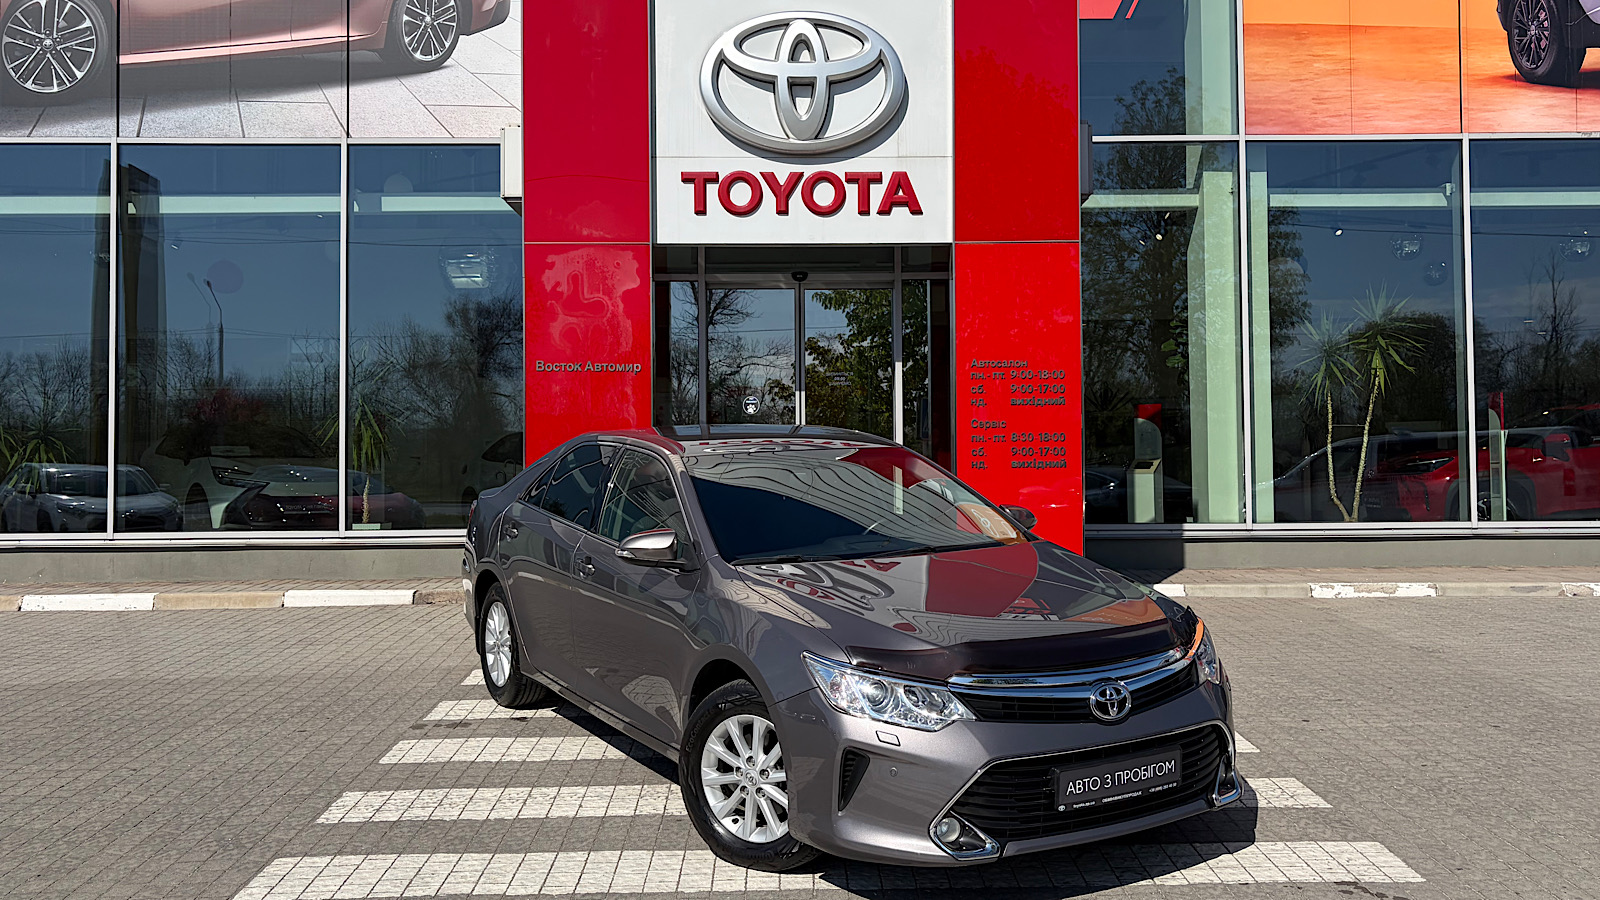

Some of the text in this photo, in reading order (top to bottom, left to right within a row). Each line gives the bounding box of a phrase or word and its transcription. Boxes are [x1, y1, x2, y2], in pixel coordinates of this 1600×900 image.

[681, 170, 923, 217] TOYOTA
[536, 360, 642, 375] Восток Автомир
[971, 359, 1028, 368] Автосалон
[1010, 370, 1065, 379] 9:00-18:00
[971, 384, 1065, 394] сб. 9:00-17:00
[971, 396, 1065, 407] нд. вихідний
[971, 419, 1006, 430] Сервіс
[1011, 433, 1066, 442] 8:30-18:00
[971, 447, 1066, 457] сб. 9:00-17:00
[971, 459, 1067, 470] нд. вихідний
[1066, 777, 1100, 795] АВТО
[1115, 760, 1175, 785] ПРОБІГОМ
